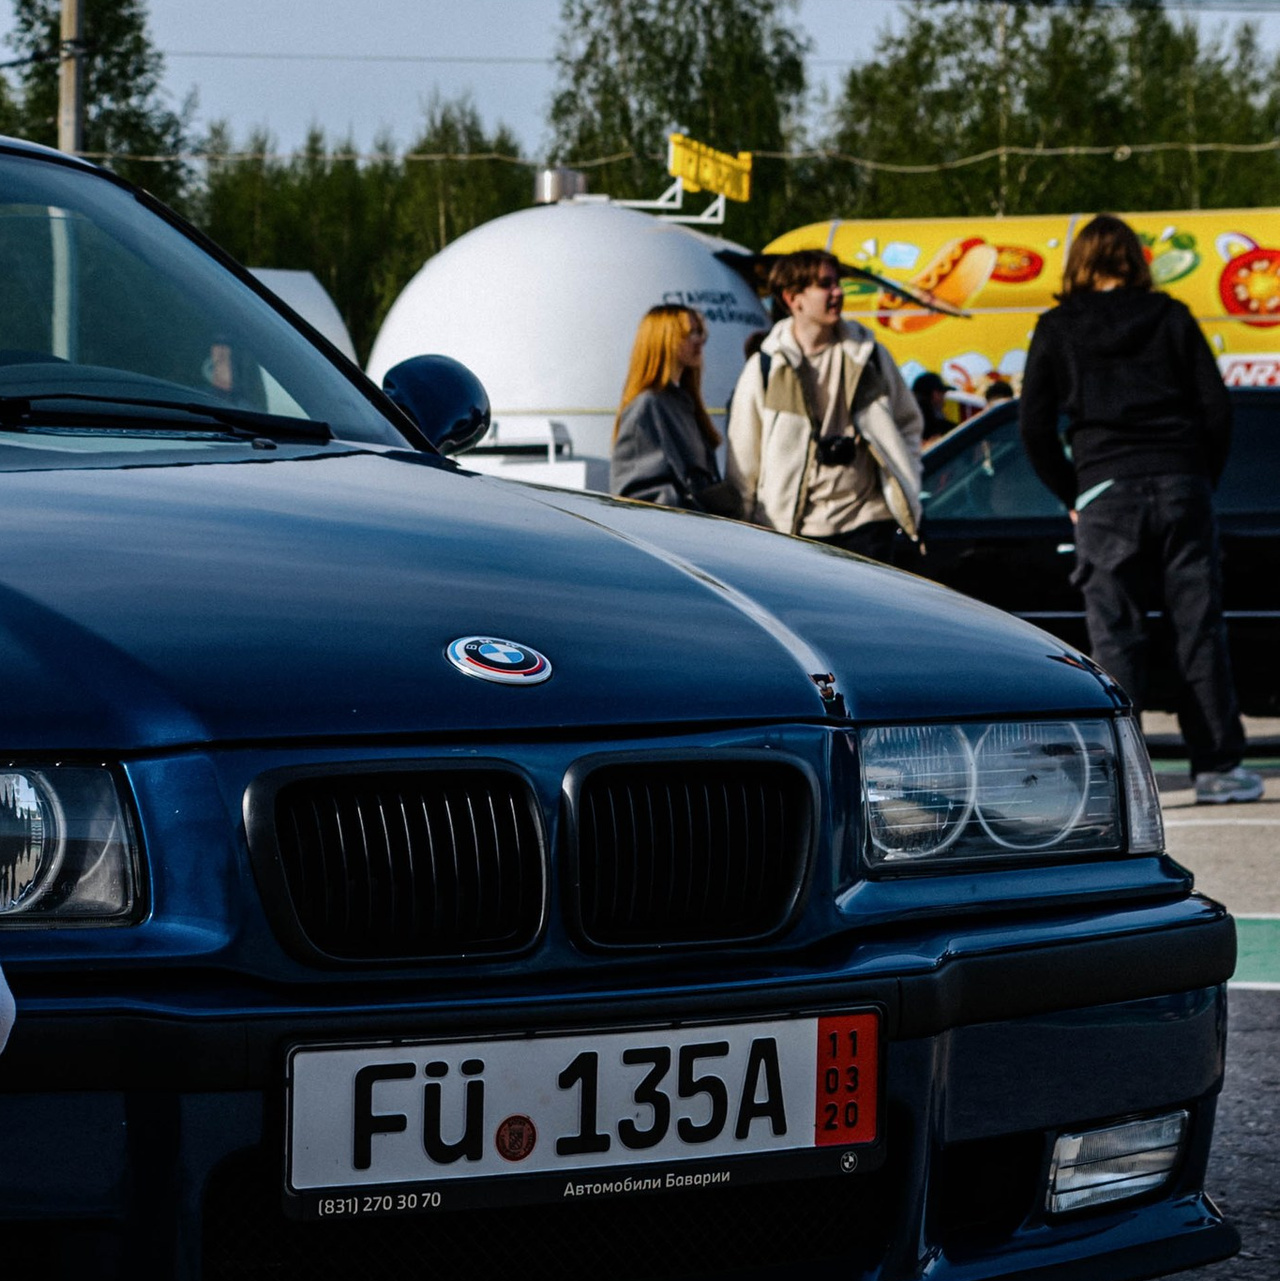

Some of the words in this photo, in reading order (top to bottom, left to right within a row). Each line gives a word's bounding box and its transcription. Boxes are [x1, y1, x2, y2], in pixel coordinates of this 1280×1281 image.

[828, 1030, 858, 1058] 11
[825, 1067, 859, 1094] 03
[556, 1037, 788, 1156] 135A
[824, 1102, 858, 1131] 20
[563, 1177, 662, 1197] Автомобили
[665, 1171, 731, 1188] Баварии
[318, 1198, 358, 1216] (831)
[362, 1195, 393, 1212] 270
[396, 1193, 418, 1210] 30
[421, 1191, 442, 1208] 70
